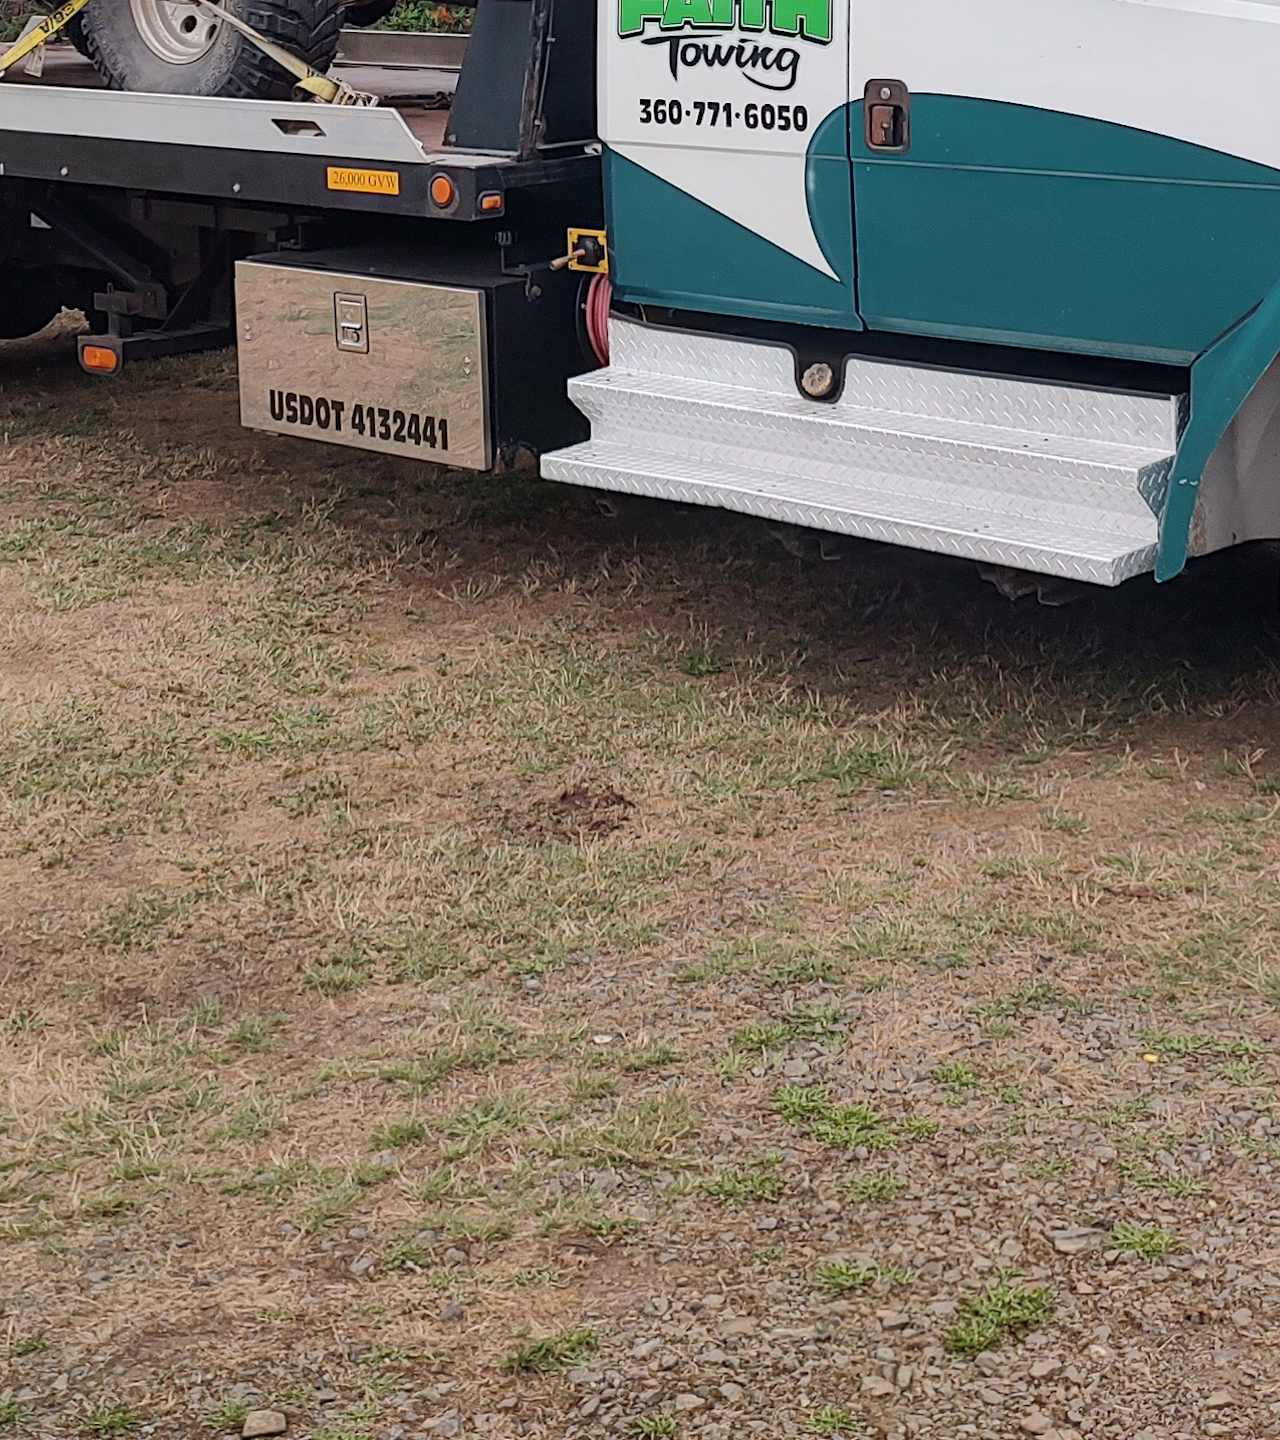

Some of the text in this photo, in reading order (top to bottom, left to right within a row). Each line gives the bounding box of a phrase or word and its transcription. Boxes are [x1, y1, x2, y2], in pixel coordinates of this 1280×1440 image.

[641, 34, 801, 91] Towing
[270, 389, 448, 450] USDOT 4132441
